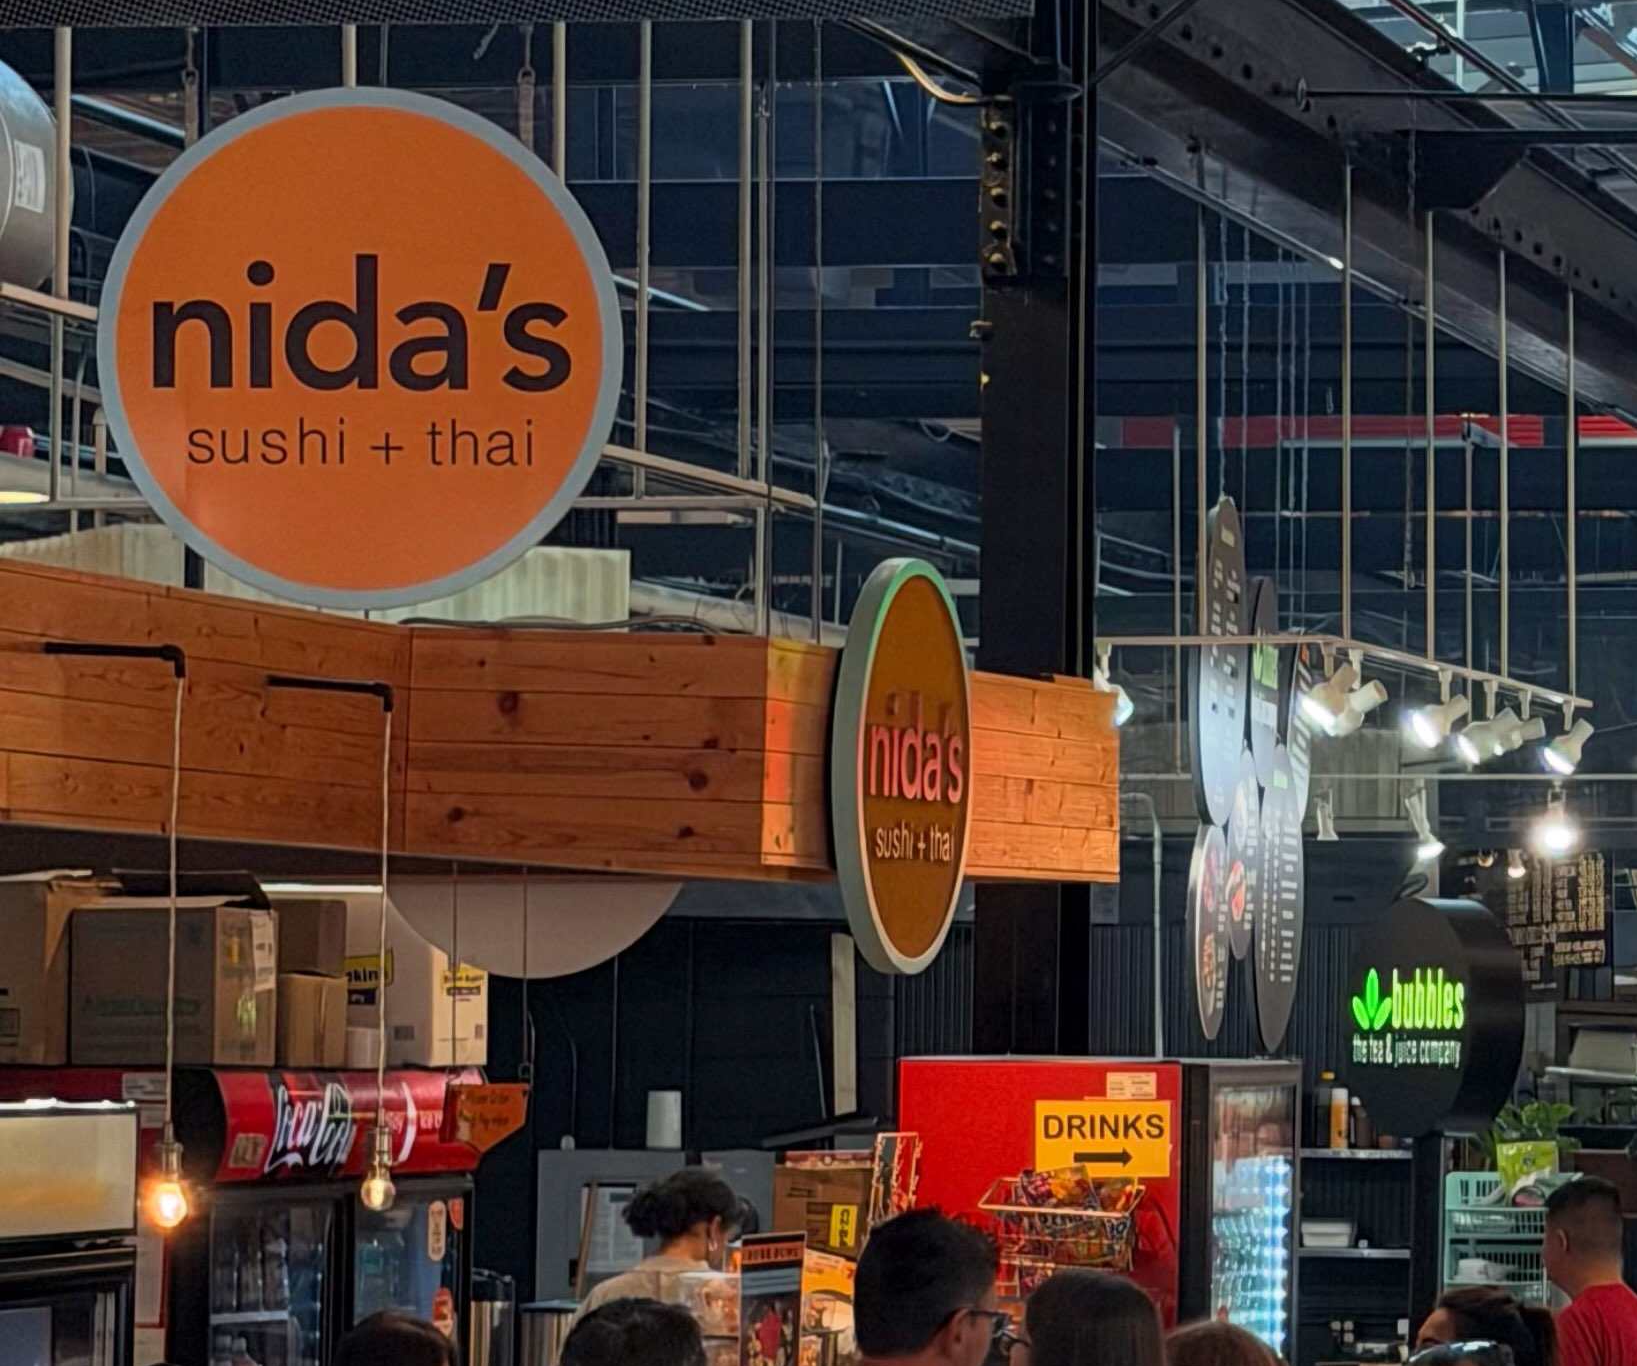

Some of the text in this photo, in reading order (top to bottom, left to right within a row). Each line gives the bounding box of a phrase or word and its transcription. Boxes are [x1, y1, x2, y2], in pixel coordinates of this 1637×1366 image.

[151, 253, 572, 394] nida's
[187, 418, 346, 466] sushi
[427, 418, 533, 467] thai
[868, 691, 963, 805] nida's
[875, 821, 914, 859] sushi
[929, 824, 954, 862] thai
[1391, 967, 1465, 1030] bubbles
[1352, 1032, 1462, 1069] the tea & juice company
[1042, 1113, 1166, 1140] DRINKS
